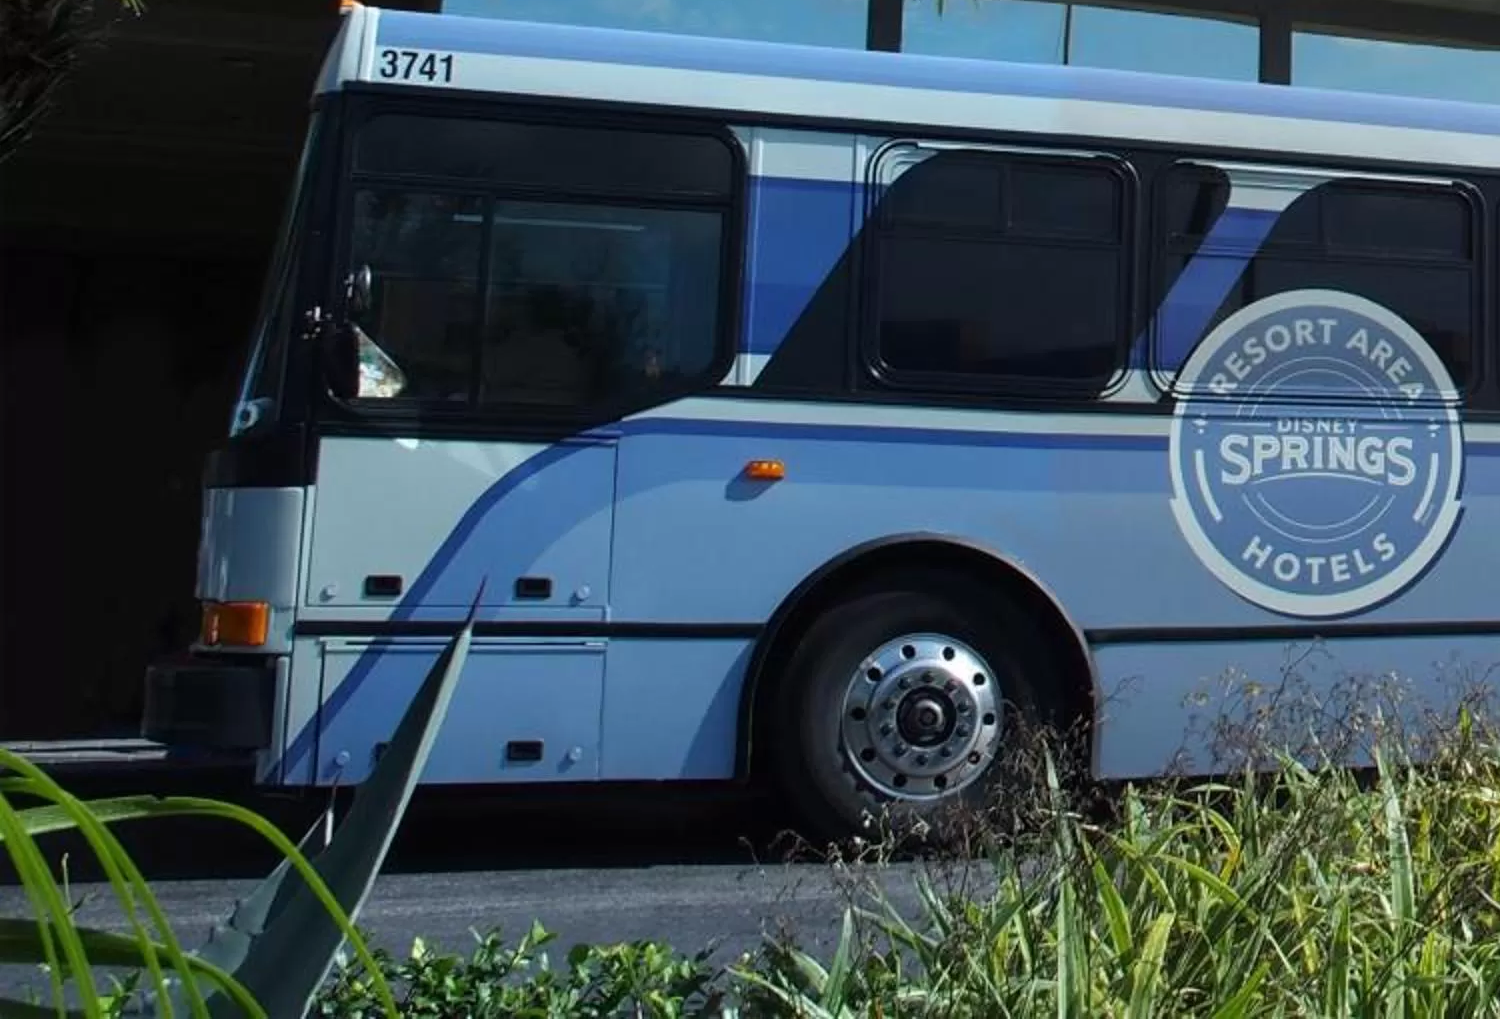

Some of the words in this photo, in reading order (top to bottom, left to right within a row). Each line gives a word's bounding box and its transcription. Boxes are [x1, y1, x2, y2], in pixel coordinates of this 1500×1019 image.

[380, 50, 453, 82] 3741
[1209, 318, 1337, 400] RESORT
[1346, 328, 1425, 407] AREA
[1277, 417, 1357, 434] DISNEY
[1219, 435, 1416, 486] SPRINGS
[1242, 533, 1395, 585] HOTELS
